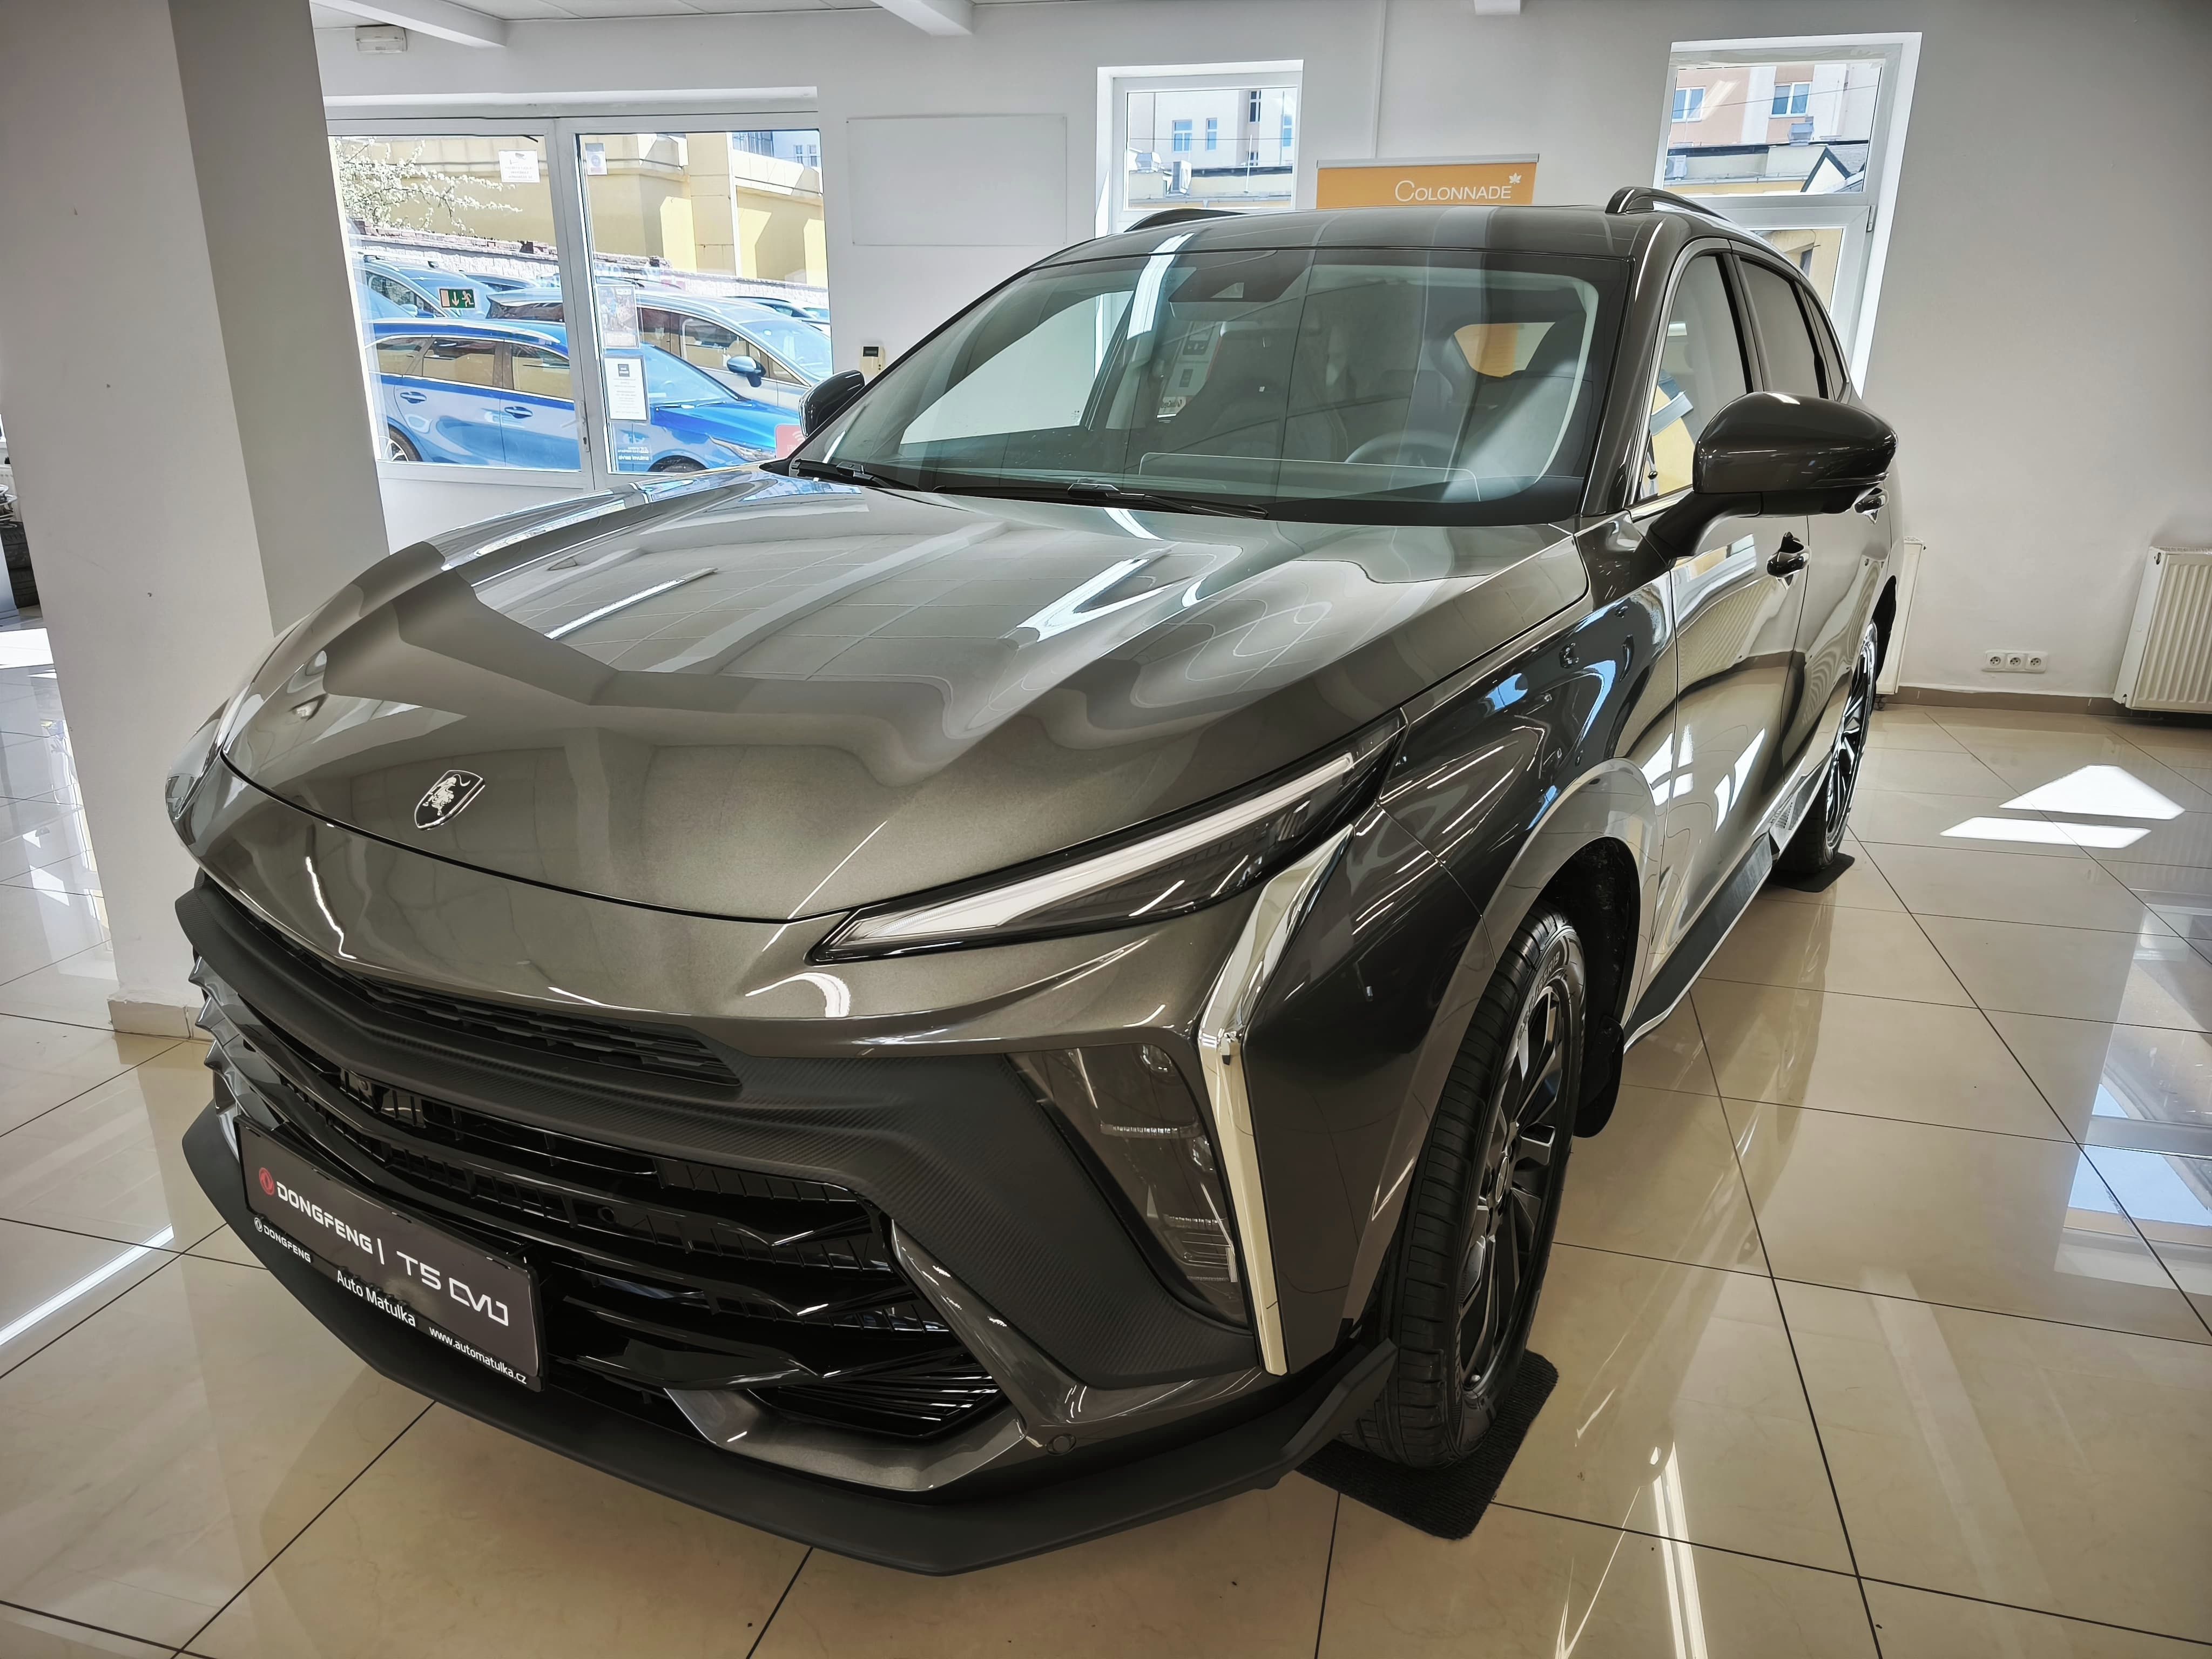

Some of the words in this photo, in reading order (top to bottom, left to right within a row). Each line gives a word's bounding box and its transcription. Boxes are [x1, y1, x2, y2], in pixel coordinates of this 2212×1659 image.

[1395, 180, 1512, 202] COLONNADE
[276, 1181, 373, 1255] DONGFENG
[396, 1250, 441, 1291] T5
[263, 1225, 311, 1263] DONGFENG
[338, 1270, 363, 1297] Auto
[366, 1287, 415, 1327] Matulka
[429, 1327, 527, 1384] www.automatulka.cz
